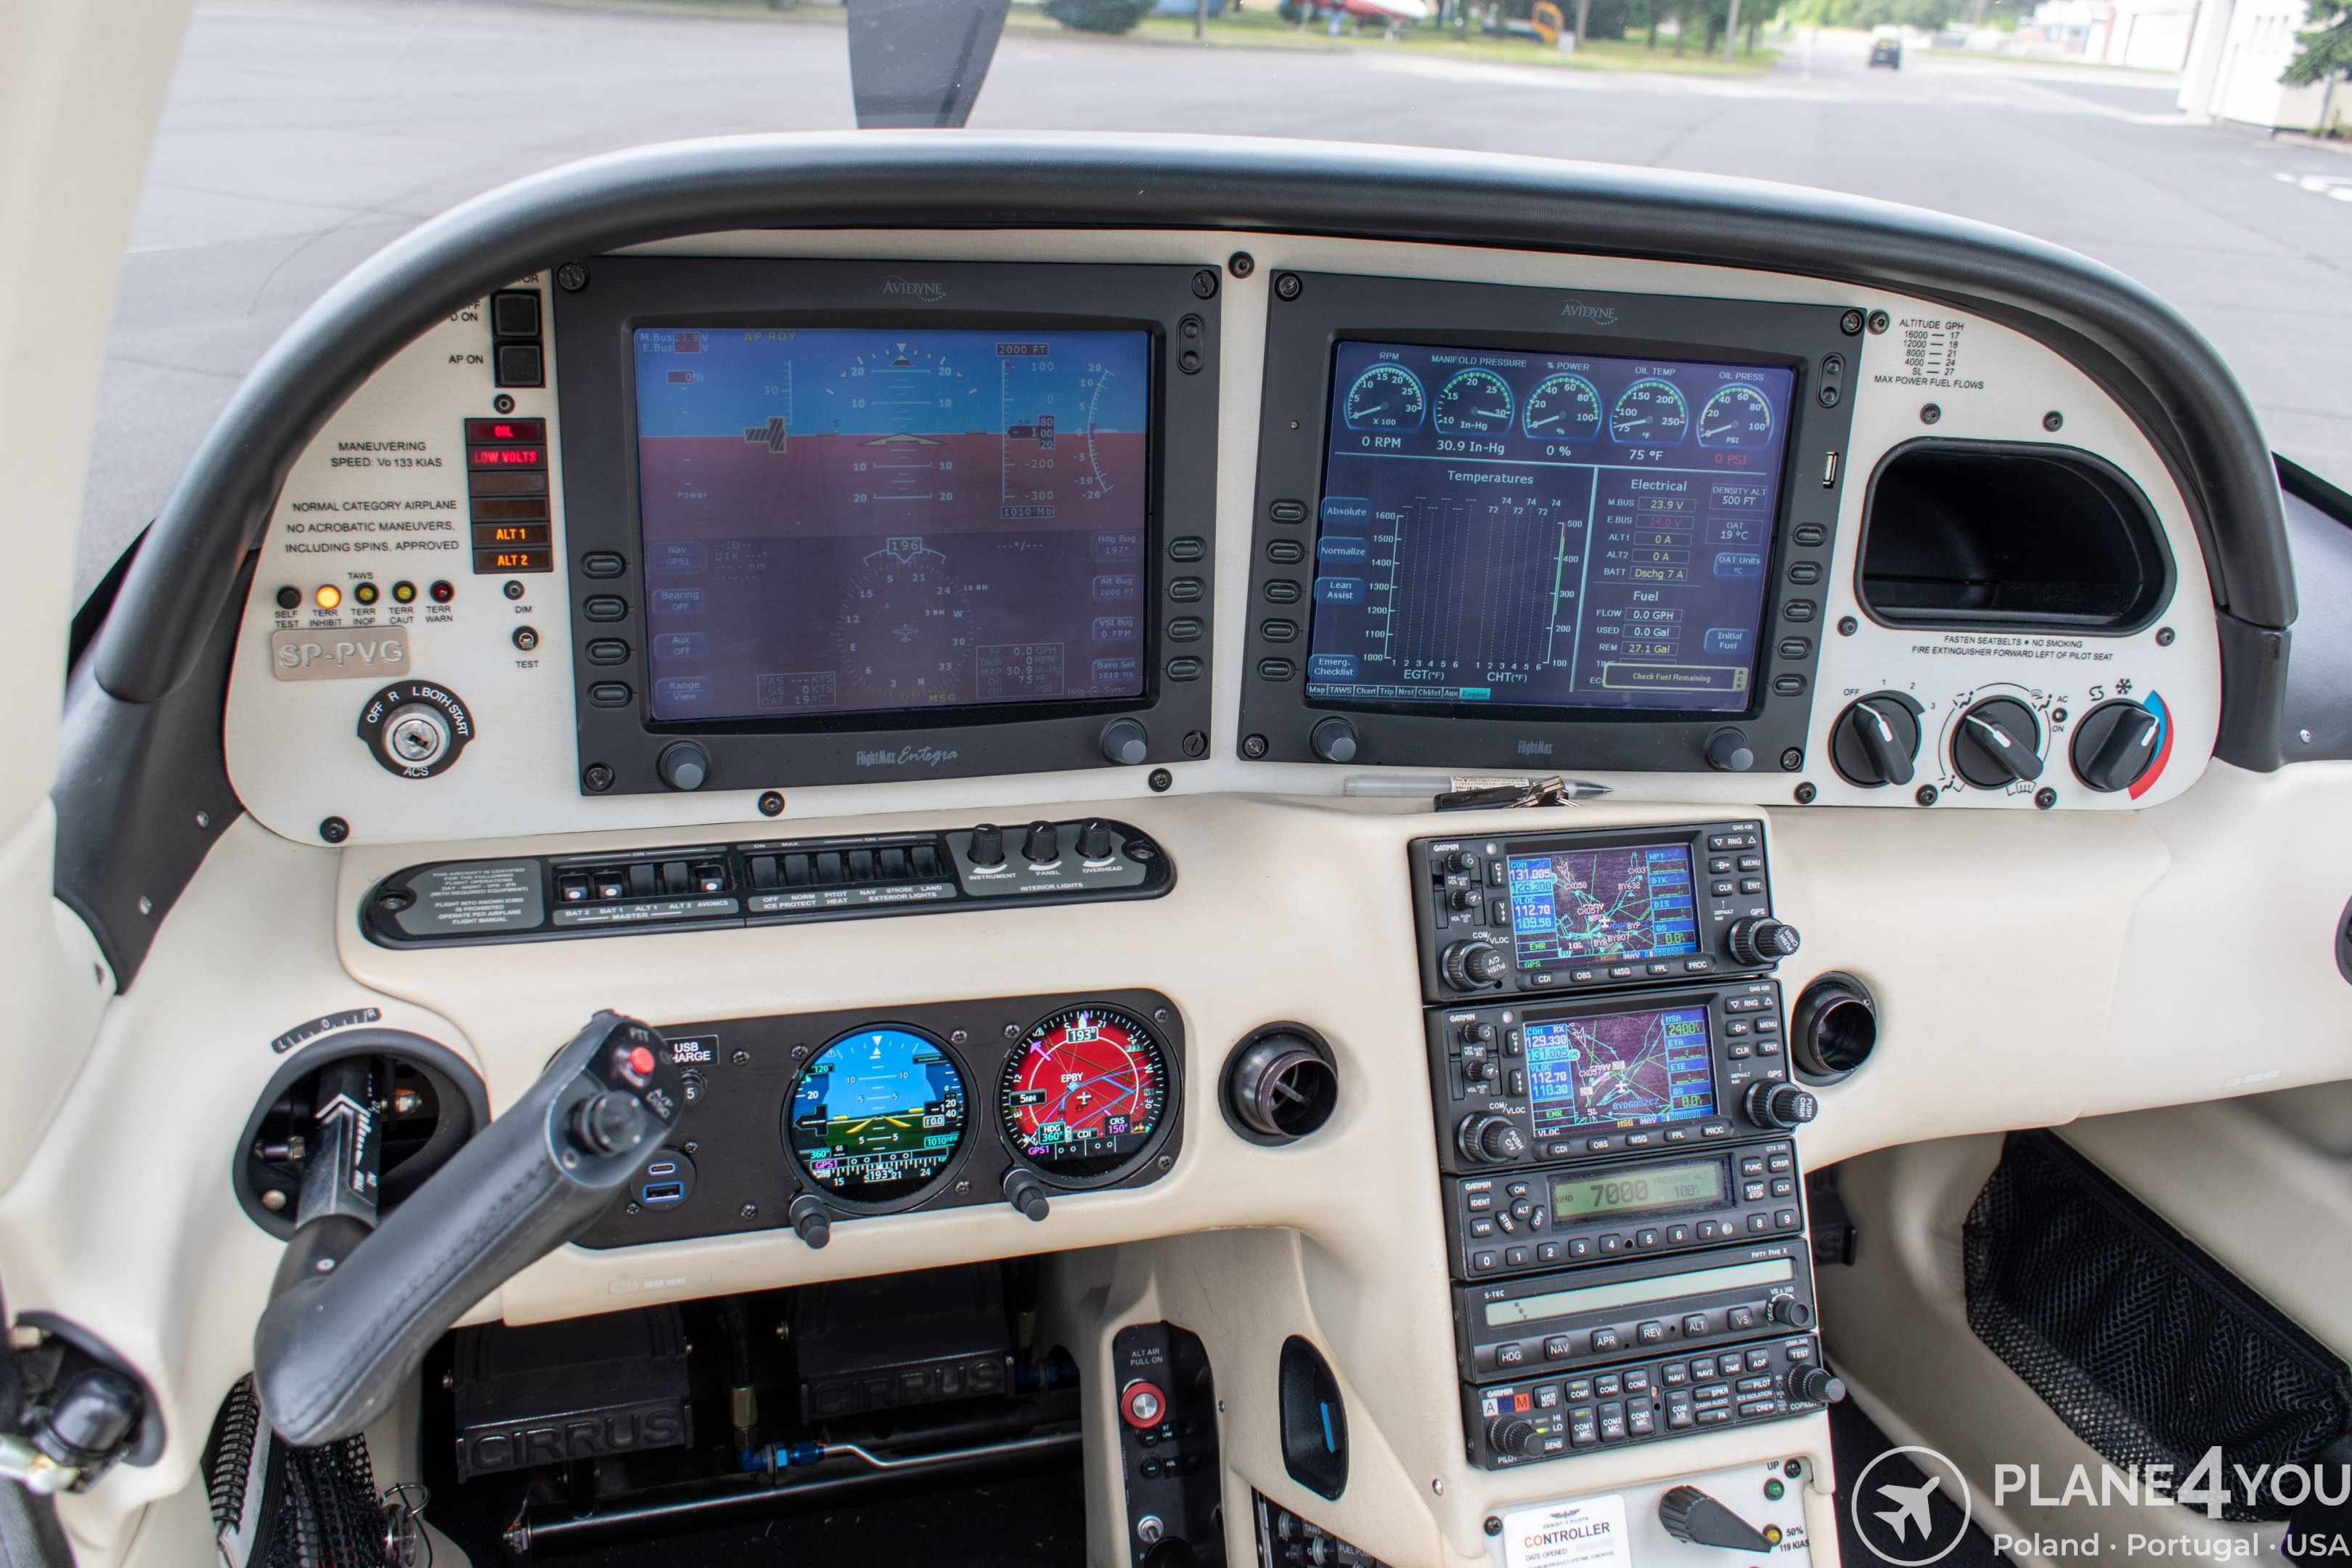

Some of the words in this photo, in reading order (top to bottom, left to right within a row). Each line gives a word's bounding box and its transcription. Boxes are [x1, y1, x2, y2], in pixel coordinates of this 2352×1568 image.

[1900, 319, 1940, 329] ALTITUDE
[1945, 322, 1964, 330] GPH
[1000, 345, 1026, 354] 2000
[1034, 345, 1046, 354] FT
[1432, 356, 1477, 364] MANIFOLD
[1479, 358, 1527, 367] PRESSURE
[1895, 376, 1928, 385] POWER
[1930, 378, 1951, 387] FUEL
[1953, 380, 1984, 389] FLOWS
[494, 426, 513, 436] OIL
[339, 442, 426, 452] MANEUVERING
[1437, 441, 1465, 451] 30.9
[1470, 441, 1504, 455] In-Hg
[332, 458, 374, 467] SPEED:
[377, 458, 392, 467] Vo
[416, 458, 442, 467] KIAS
[1447, 471, 1533, 485] Temperatures
[1631, 480, 1686, 491] Electrical
[293, 502, 339, 511] NORMAL
[343, 502, 401, 511] CATEGORY
[405, 501, 457, 510] AIRPLANE
[1327, 507, 1366, 516] Absolute
[287, 524, 304, 533] NO
[309, 523, 376, 533] ACROBATIC
[497, 530, 516, 539] ALT
[520, 529, 525, 539] 1
[286, 543, 351, 552] INCLUDING
[396, 541, 459, 550] APPROVED
[891, 540, 918, 551] 196
[1321, 547, 1365, 556] Normalize
[497, 556, 518, 566] ALT
[520, 555, 528, 565] 2
[1634, 592, 1658, 601] Fuel
[1944, 635, 1975, 644] FASTEN
[1977, 637, 2022, 645] SEATBELTS
[2046, 640, 2082, 648] SMOKING
[280, 640, 404, 668] SP-PVG
[1932, 647, 1991, 656] EXTINGUISHER
[1993, 649, 2033, 658] FORWARD
[2035, 650, 2054, 658] LEFT
[1673, 674, 1710, 683] Remaining
[422, 687, 452, 707] BOTH
[1462, 690, 1487, 699] Engine
[367, 702, 384, 723] OFF
[448, 704, 468, 735] START
[898, 746, 958, 766] Entegra
[1434, 843, 1458, 852] GARMIN
[1510, 868, 1551, 881] 131.005
[780, 900, 816, 909] PROTECT
[1516, 905, 1551, 916] 112.70
[1689, 960, 1707, 969] PROC
[1526, 1035, 1567, 1047] 129.330
[674, 1042, 698, 1053] USB
[1061, 1072, 1084, 1083] EPBY
[1077, 1130, 1091, 1138] CDI
[1745, 1162, 1762, 1171] FUNC
[1772, 1159, 1789, 1168] CRSR
[1591, 1180, 1649, 1207] 7000
[1747, 1185, 1764, 1193] START
[1471, 1198, 1490, 1206] IDENT
[1517, 1205, 1529, 1214] ALT
[1485, 1290, 1504, 1299] S-TEC
[1689, 1320, 1704, 1331] ALT
[1736, 1315, 1748, 1325] VS
[1643, 1328, 1661, 1339] REV
[1598, 1335, 1615, 1346] APR
[1551, 1344, 1568, 1355] NAV
[1502, 1350, 1521, 1362] HDG
[814, 1360, 1003, 1416] CIRRUS
[1600, 1385, 1617, 1394] COM2
[1753, 1379, 1771, 1389] PILOT
[1571, 1389, 1588, 1398] COM1
[1711, 1387, 1728, 1396] SPKR
[472, 1409, 680, 1472] CIRRUS
[1768, 1461, 1779, 1471] UP
[1524, 1522, 1610, 1548] CONTROLLER
[1787, 1527, 1803, 1537] 50%
[1779, 1542, 1791, 1551] 119
[1792, 1539, 1809, 1549] KIAS
